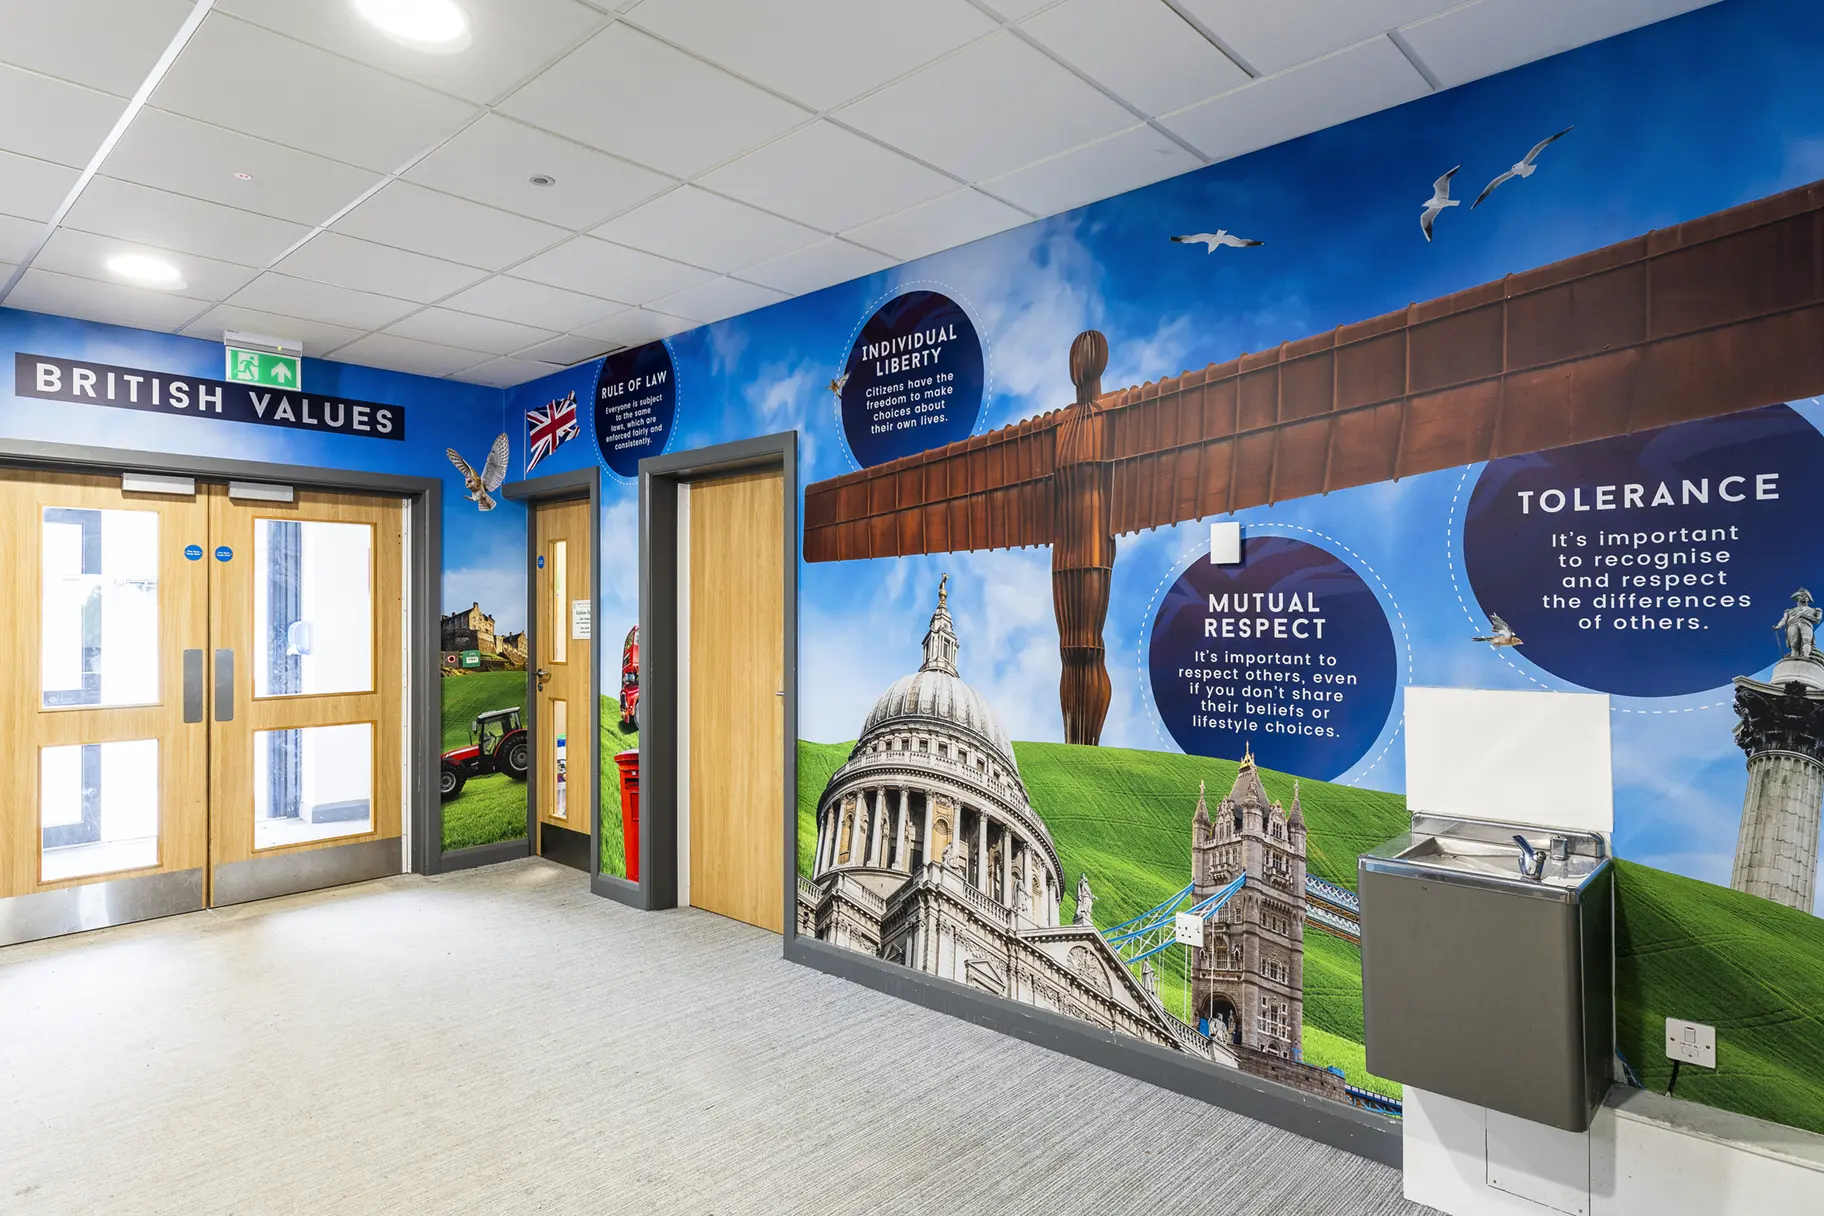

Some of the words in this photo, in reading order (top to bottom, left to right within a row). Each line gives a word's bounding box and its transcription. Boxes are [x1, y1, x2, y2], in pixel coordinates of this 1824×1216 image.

[862, 324, 957, 361] INDIVIDUAL
[877, 347, 941, 376] LIBERTY
[602, 382, 624, 399] RULE
[628, 378, 641, 391] OF
[646, 371, 667, 387] LAW
[866, 383, 904, 397] Citizens
[908, 377, 932, 389] have
[937, 373, 953, 383] the
[36, 362, 223, 413] BRITISH
[249, 392, 392, 433] VALUES
[605, 402, 631, 415] Everyone
[632, 399, 638, 408] is
[640, 394, 662, 405] subject
[867, 396, 906, 410] freedom
[910, 393, 920, 401] to
[925, 386, 953, 398] make
[615, 413, 622, 422] to
[622, 411, 634, 420] the
[634, 407, 651, 417] same
[873, 408, 911, 421] choices
[915, 400, 945, 413] about
[606, 431, 631, 442] enforced
[632, 427, 649, 437] fairly
[650, 424, 662, 433] and
[610, 420, 626, 432] laws,
[627, 419, 644, 428] which
[871, 422, 893, 434] their
[897, 419, 917, 429] own
[921, 414, 948, 425] lives.
[615, 437, 653, 451] consistently.
[1518, 473, 1779, 514] TOLERANCE
[1552, 531, 1587, 547] It's
[1600, 526, 1738, 549] important
[1559, 554, 1582, 567] to
[1595, 548, 1730, 569] recognise
[1562, 573, 1608, 588] and
[1623, 571, 1727, 591] respect
[1209, 592, 1320, 613] MUTUAL
[1543, 594, 1581, 608] the
[1593, 593, 1750, 608] differences
[1205, 618, 1326, 639] RESPECT
[1579, 614, 1601, 629] of
[1614, 615, 1708, 629] others.
[1195, 650, 1218, 662] It's
[1225, 651, 1311, 667] important
[1319, 654, 1336, 666] to
[1179, 669, 1238, 682] respect
[1245, 669, 1305, 684] others,
[1313, 673, 1357, 685] even
[1190, 682, 1199, 694] if
[1206, 686, 1234, 698] you
[1242, 685, 1284, 699] don't
[1292, 688, 1343, 702] share
[1201, 700, 1238, 713] their
[1246, 702, 1304, 717] beliefs
[1312, 709, 1330, 719] or
[1193, 715, 1258, 733] lifestyle
[1265, 721, 1339, 737] choices.
